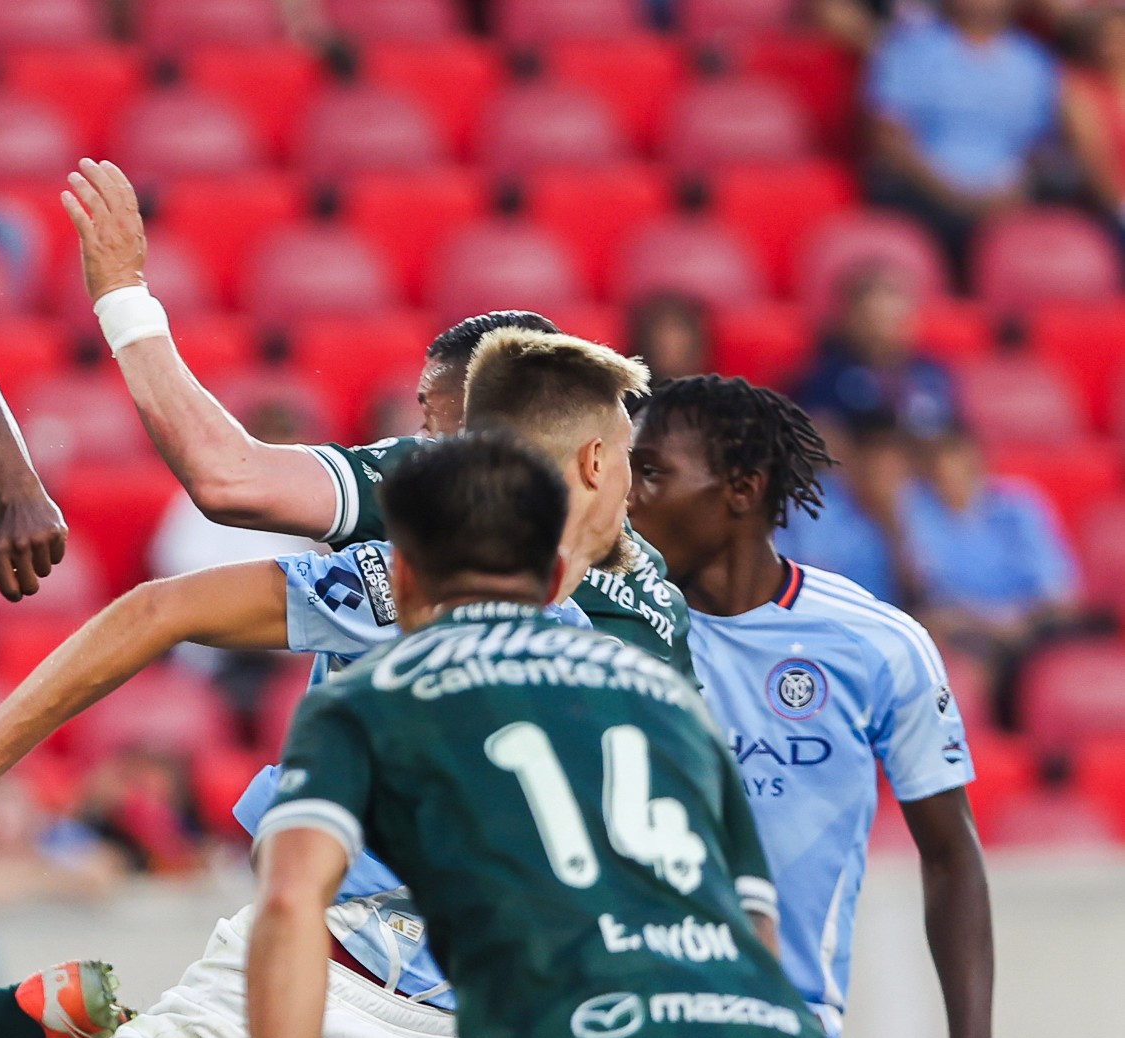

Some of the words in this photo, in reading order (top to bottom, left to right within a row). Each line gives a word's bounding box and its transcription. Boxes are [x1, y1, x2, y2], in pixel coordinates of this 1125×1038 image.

[360, 560, 378, 589] CUP
[369, 557, 398, 621] LEAGUES
[483, 720, 707, 896] 14
